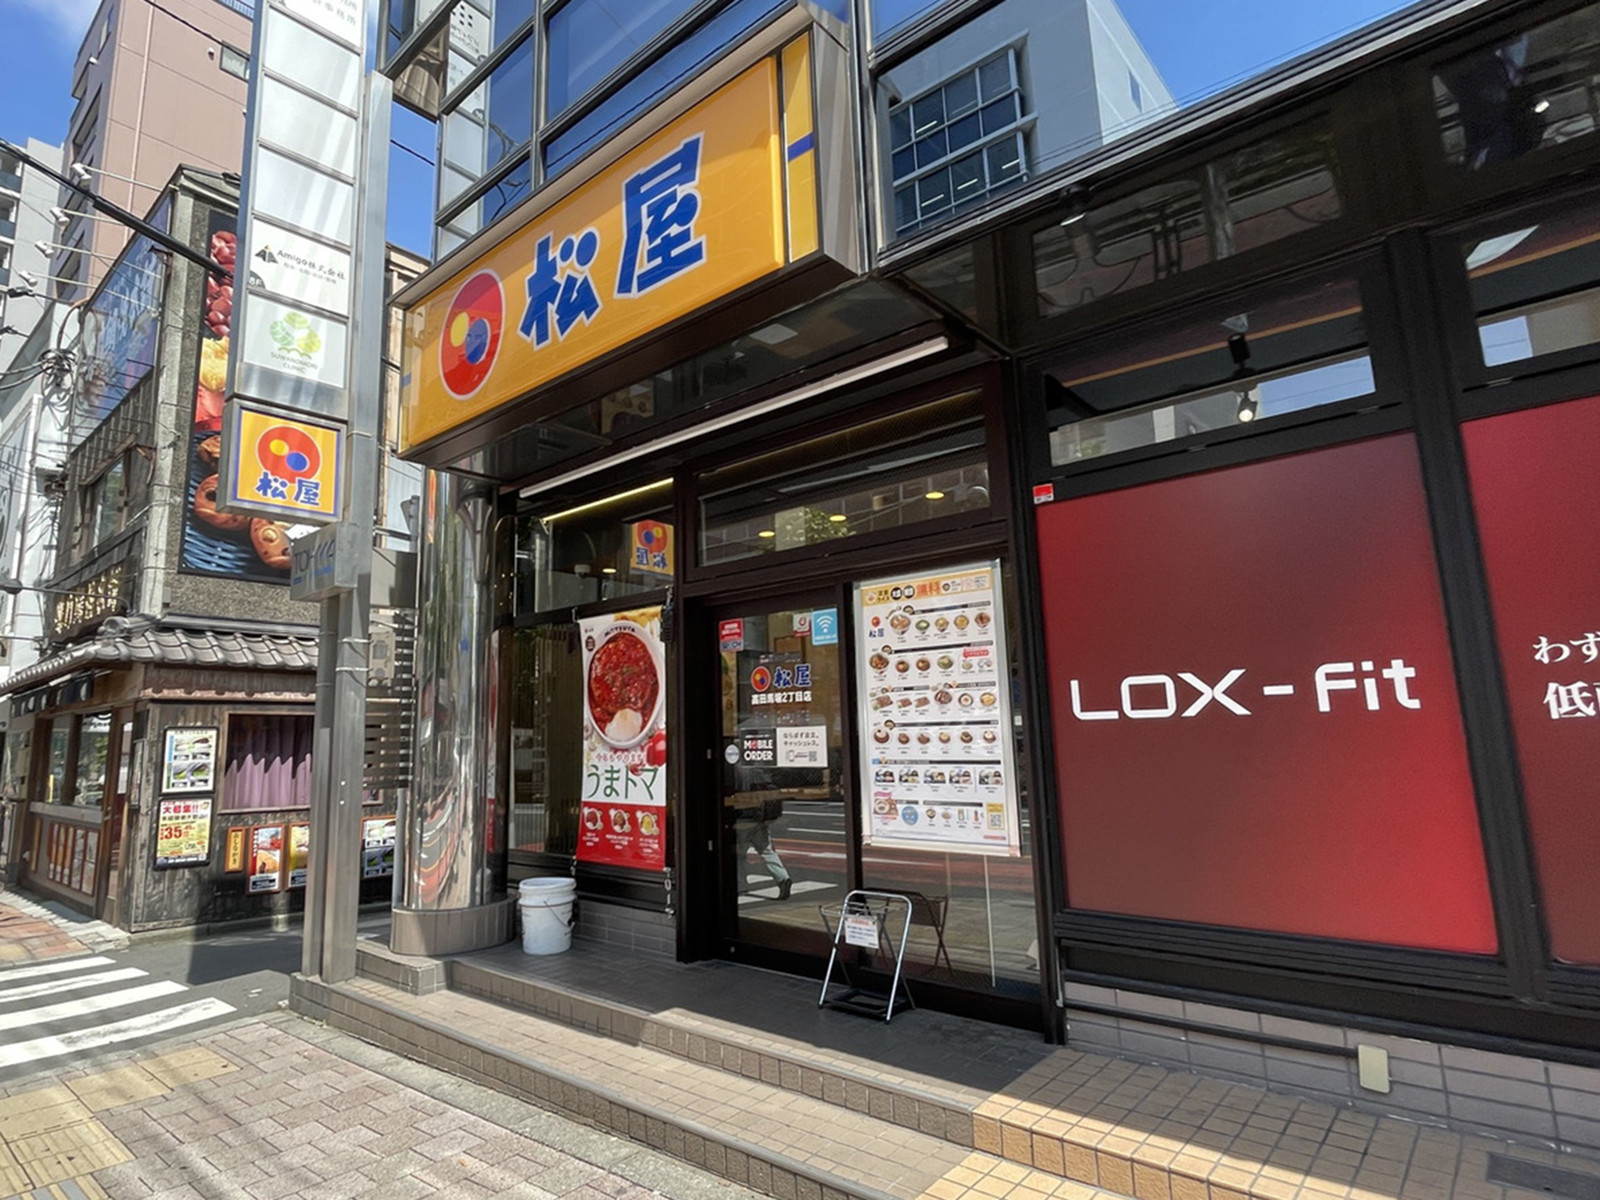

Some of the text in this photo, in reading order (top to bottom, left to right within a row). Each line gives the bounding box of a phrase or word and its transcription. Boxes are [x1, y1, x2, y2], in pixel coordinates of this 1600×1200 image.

[518, 132, 706, 350] 松屋
[255, 470, 320, 506] 松屋
[773, 664, 812, 689] 松屋
[1542, 680, 1600, 720] 低
[743, 750, 774, 761] ORDER
[587, 763, 659, 801] うまトマ
[164, 825, 183, 839] 35
